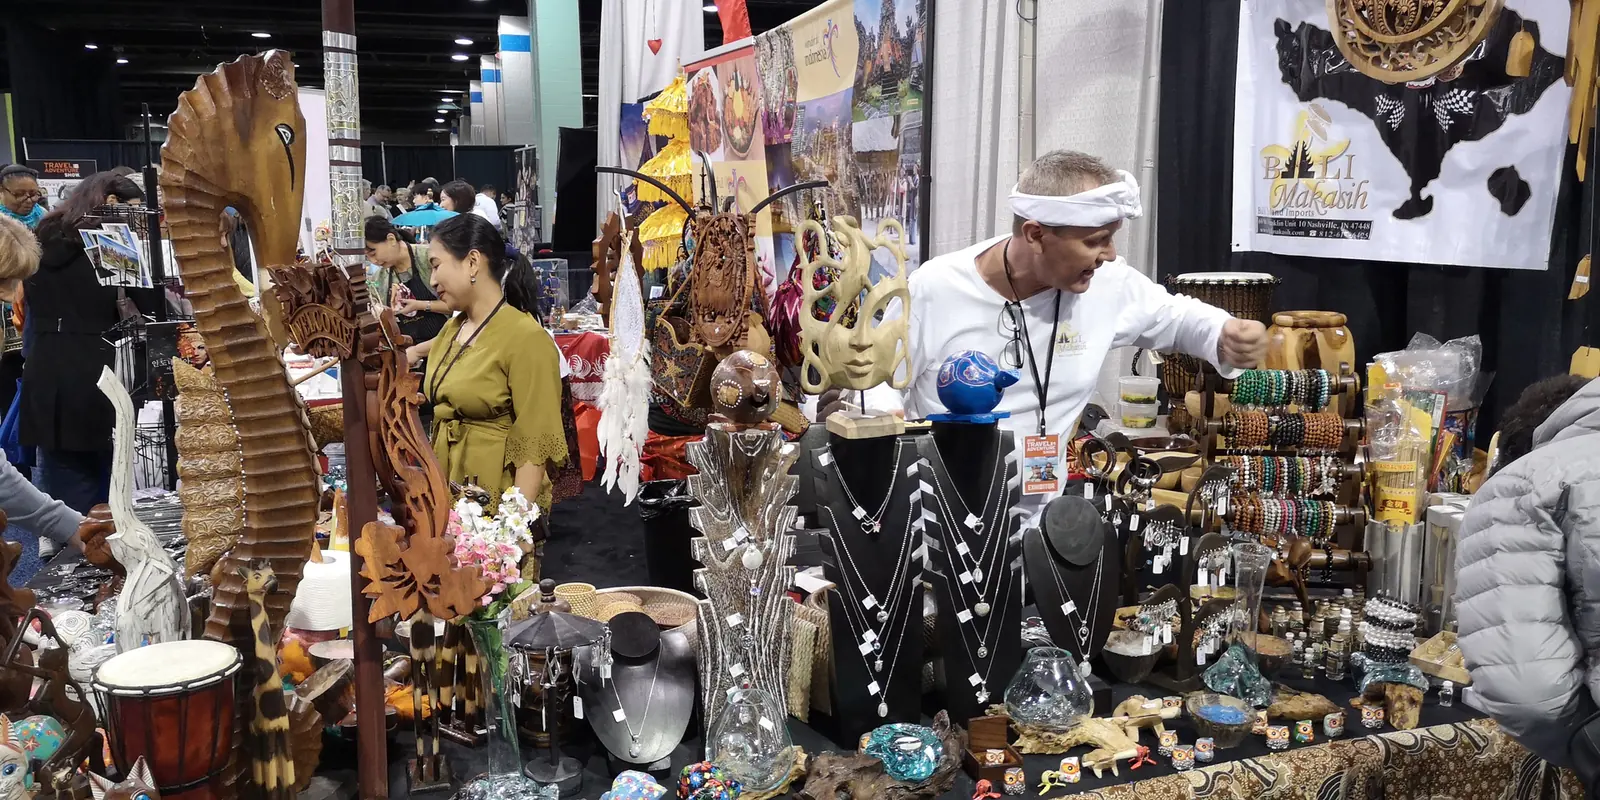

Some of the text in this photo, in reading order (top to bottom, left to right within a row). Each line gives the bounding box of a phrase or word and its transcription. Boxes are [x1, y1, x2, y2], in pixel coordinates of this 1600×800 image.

[1272, 180, 1369, 215] Makasih
[1286, 208, 1316, 219] Imports
[1308, 220, 1339, 230] Nashville,
[1350, 222, 1371, 230] 47448
[293, 309, 351, 344] WELCOME
